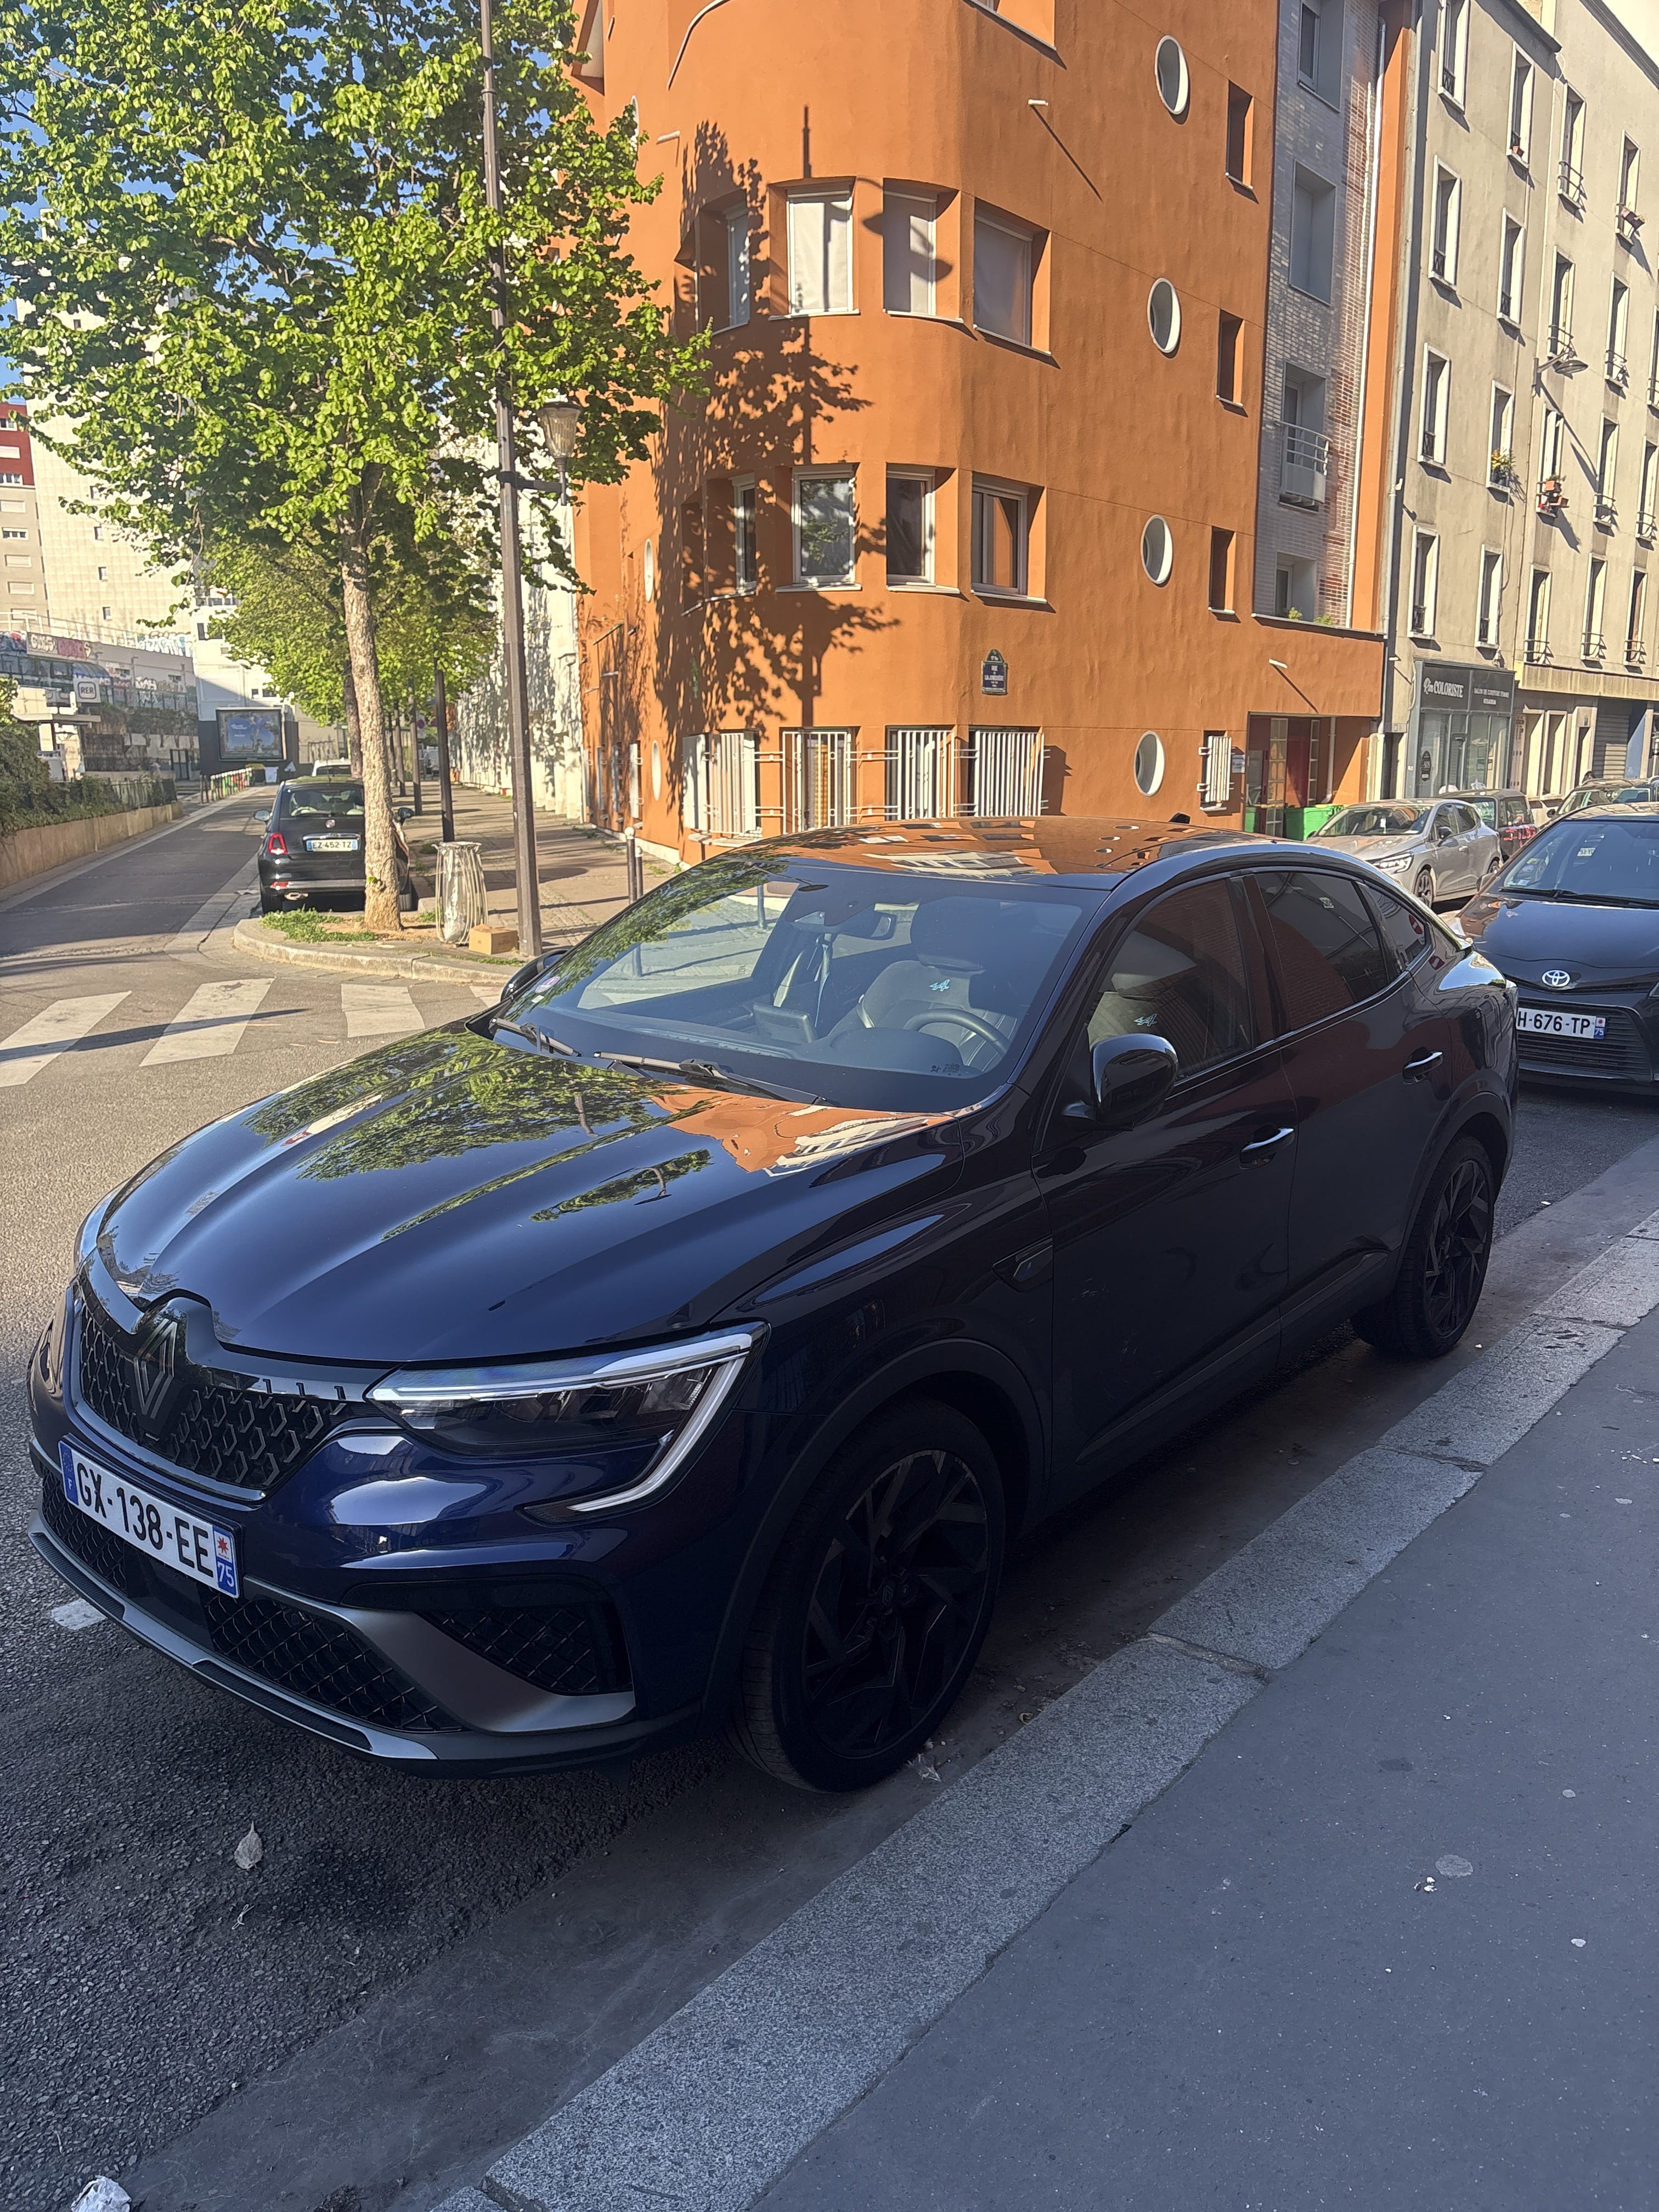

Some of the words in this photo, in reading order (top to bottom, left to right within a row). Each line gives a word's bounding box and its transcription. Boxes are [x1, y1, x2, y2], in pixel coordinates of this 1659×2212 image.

[1434, 680, 1464, 698] COLORISTE
[1517, 1011, 1590, 1034] H-676-TP
[1594, 1028, 1604, 1036] 75
[67, 1478, 72, 1490] F
[77, 1463, 213, 1578] GX-138-EE
[217, 1562, 235, 1587] 75
